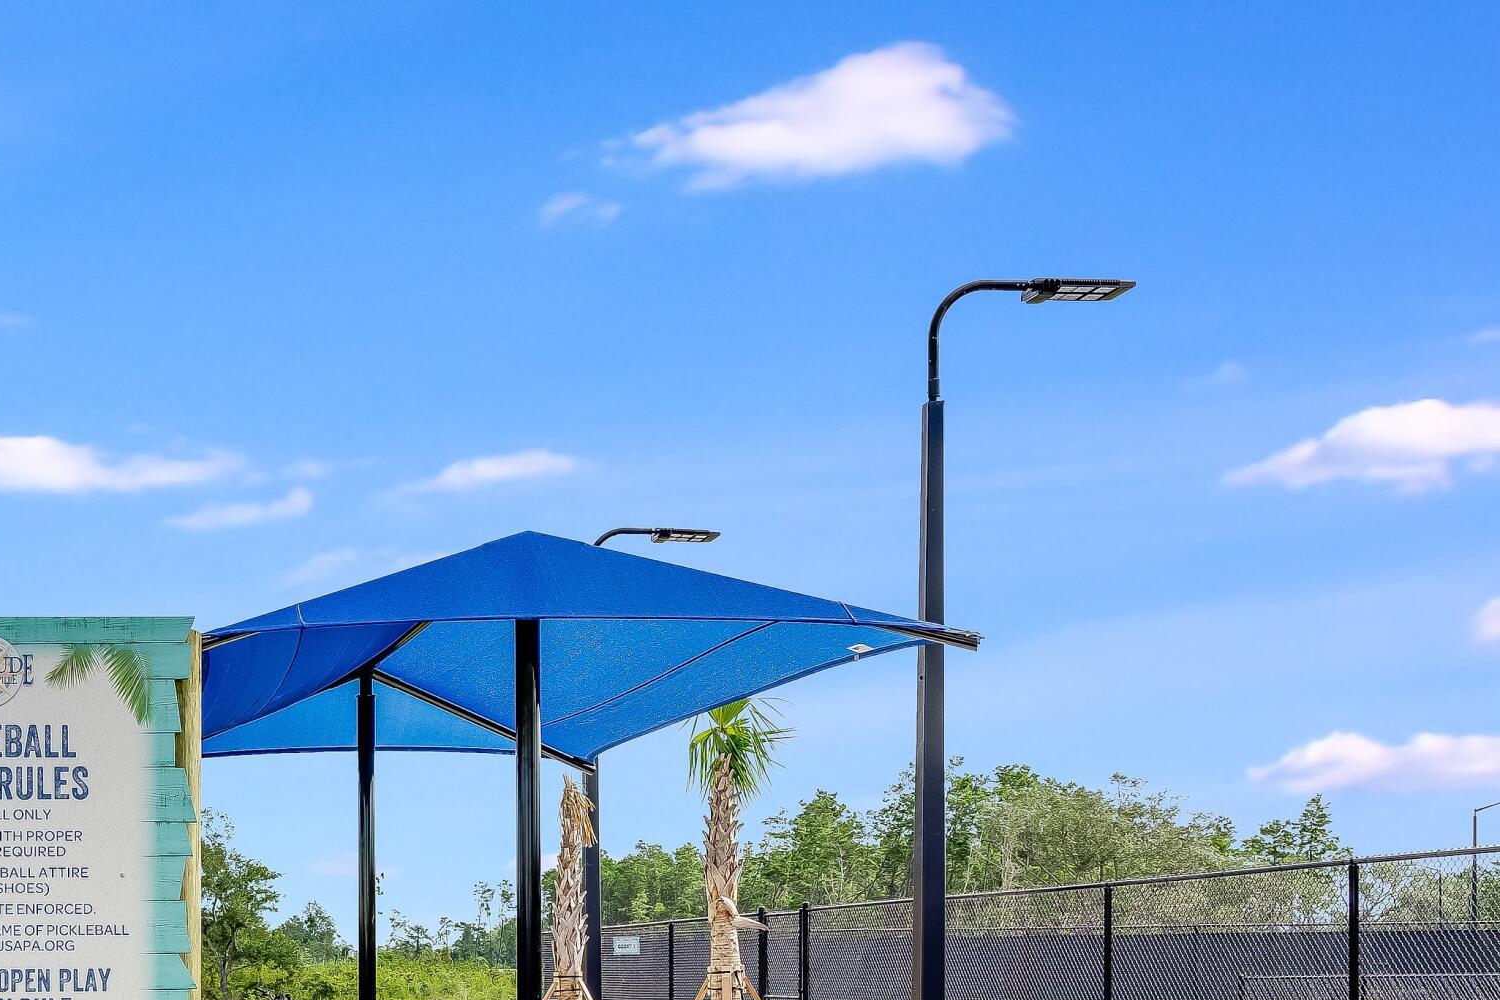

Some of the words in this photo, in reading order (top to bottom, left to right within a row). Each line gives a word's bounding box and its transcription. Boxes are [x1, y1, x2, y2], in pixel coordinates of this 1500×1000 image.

[12, 808, 52, 821] ONLY
[26, 829, 83, 842] PROPER
[37, 866, 90, 879] ATTIRE
[16, 902, 97, 916] ENFORCED.
[24, 924, 45, 937] OF
[46, 924, 130, 937] PICKLEBALL
[58, 967, 112, 993] PLAY
